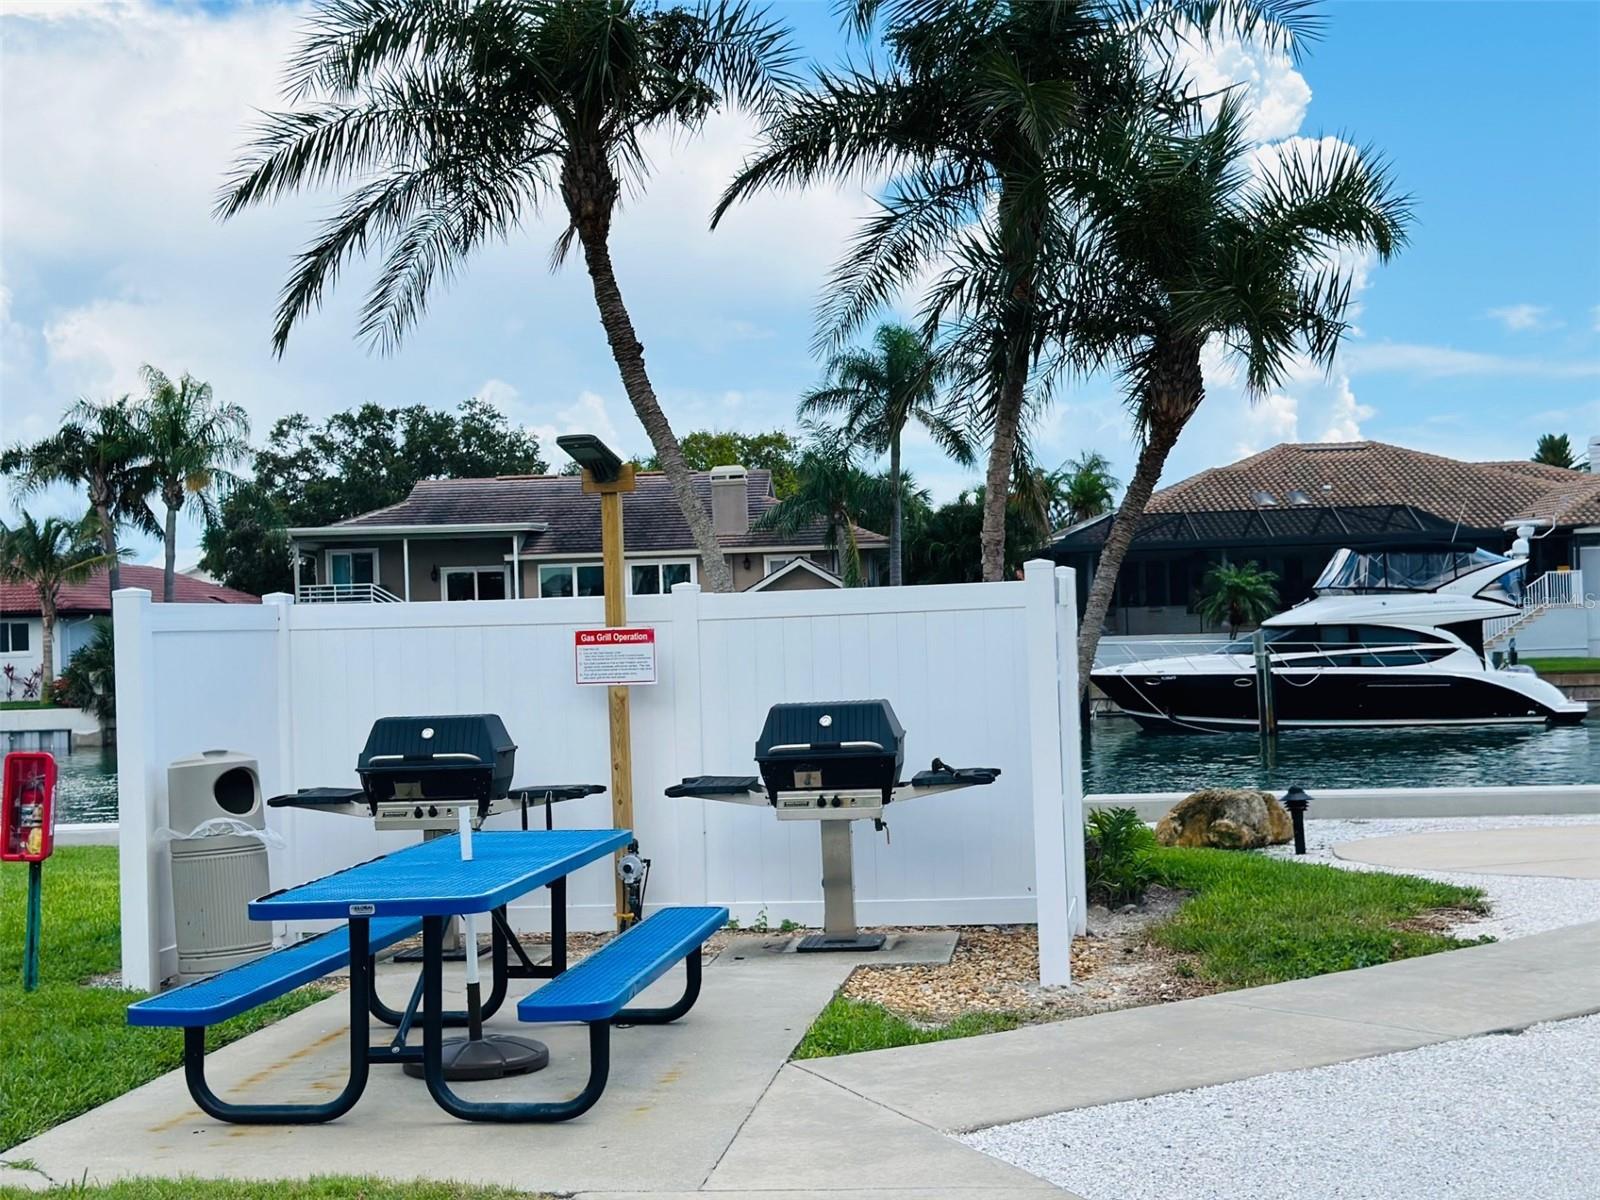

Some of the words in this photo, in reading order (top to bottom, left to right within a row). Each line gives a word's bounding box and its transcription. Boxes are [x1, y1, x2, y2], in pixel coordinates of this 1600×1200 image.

[580, 633, 595, 642] Gas
[596, 632, 612, 642] Grill
[613, 632, 648, 642] Operation
